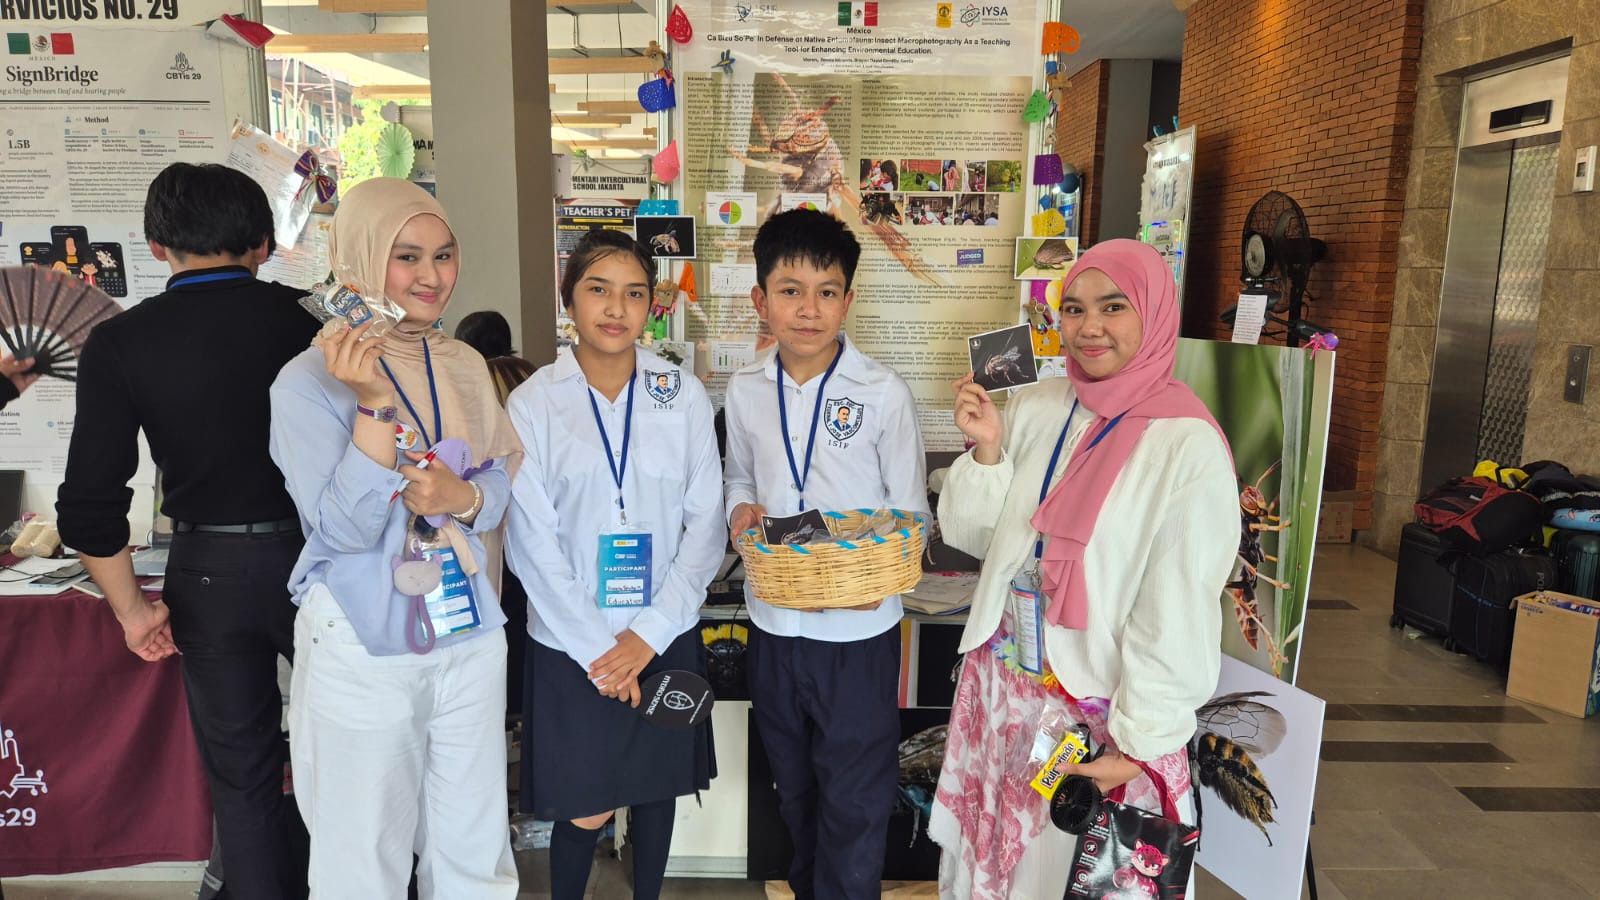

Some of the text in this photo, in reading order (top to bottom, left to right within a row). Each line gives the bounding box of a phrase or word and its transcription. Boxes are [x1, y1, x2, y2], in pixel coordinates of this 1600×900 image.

[105, 0, 142, 19] NO.
[149, 0, 179, 19] 29
[982, 6, 1008, 16] IYSA
[898, 37, 962, 45] Macrophotography
[981, 38, 1011, 46] Teaching
[811, 46, 846, 54] Enhancing
[6, 65, 99, 87] SignBridge
[13, 88, 32, 96] bridge
[8, 139, 31, 149] 1.5B
[572, 175, 647, 184] MENTARI INTERCULTURAL
[564, 207, 631, 216] TEACHER'S PET
[1040, 743, 1075, 789] Pulprindo
